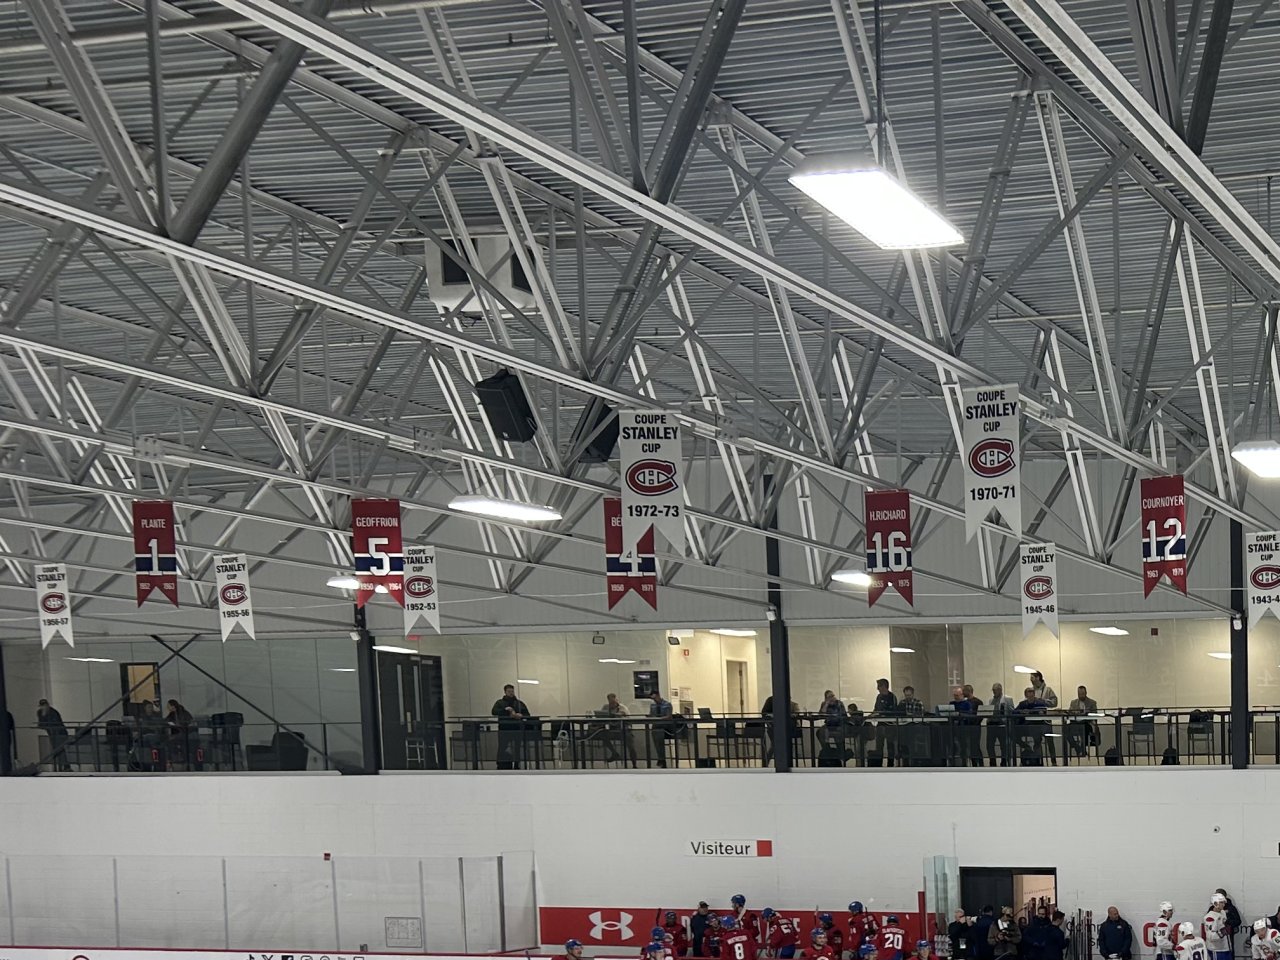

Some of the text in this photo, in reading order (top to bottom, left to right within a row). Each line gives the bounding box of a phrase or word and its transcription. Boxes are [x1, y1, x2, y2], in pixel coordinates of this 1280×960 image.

[977, 389, 1006, 402] COUPE
[966, 402, 1017, 420] STANLEY
[635, 414, 666, 424] COUPE
[983, 421, 1001, 432] CUP
[622, 426, 679, 440] STANLEY
[641, 443, 661, 453] CUP
[970, 485, 1016, 501] 1970-71
[1142, 495, 1184, 509] COURNOYER
[628, 505, 679, 517] 1972-73
[141, 518, 166, 529] PLANTE
[356, 517, 399, 527] GEOFFRION
[1146, 518, 1183, 562] 12
[1255, 534, 1277, 542] COUPE
[148, 538, 164, 575] 1
[368, 537, 391, 576] 5
[619, 537, 642, 577] 4
[872, 531, 908, 573] 16
[402, 556, 434, 565] STANLEY
[1021, 554, 1055, 564] STANLEY
[216, 564, 246, 573] STANLEY
[37, 573, 65, 582] STANLEY
[406, 603, 436, 611] 1952-53
[1025, 605, 1055, 614] 1945-46
[690, 841, 751, 855] Visiteur
[884, 933, 903, 950] 20
[733, 943, 744, 960] 8
